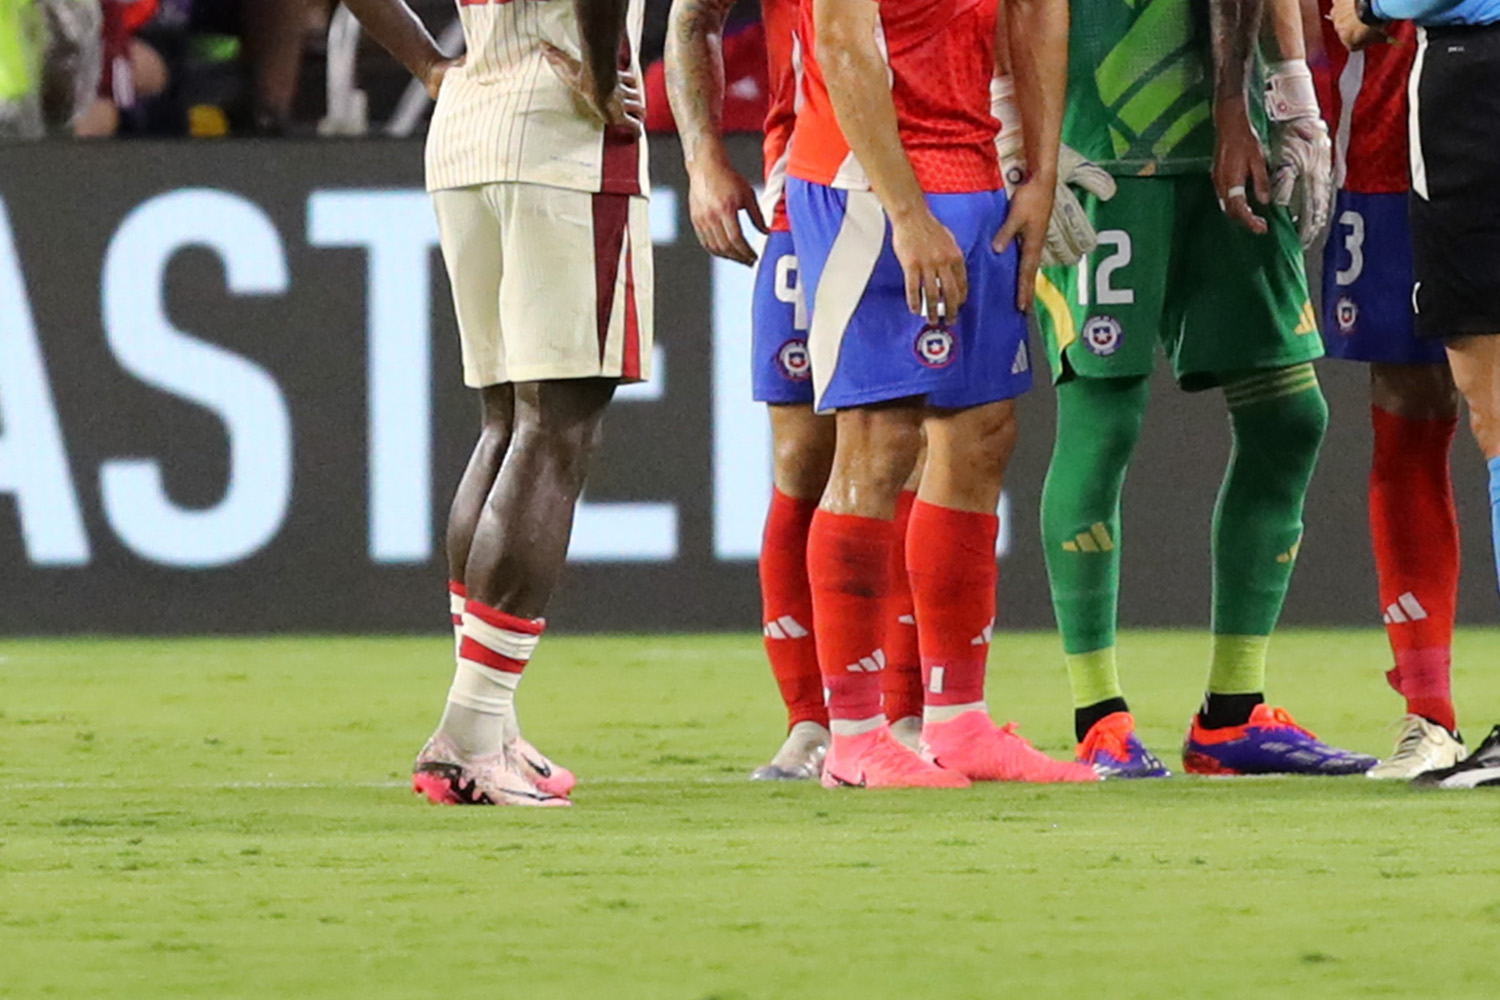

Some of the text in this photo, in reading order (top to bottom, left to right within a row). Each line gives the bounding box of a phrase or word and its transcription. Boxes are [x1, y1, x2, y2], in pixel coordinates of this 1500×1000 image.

[1077, 229, 1135, 306] 12
[1336, 210, 1365, 286] 3
[774, 254, 808, 331] 9
